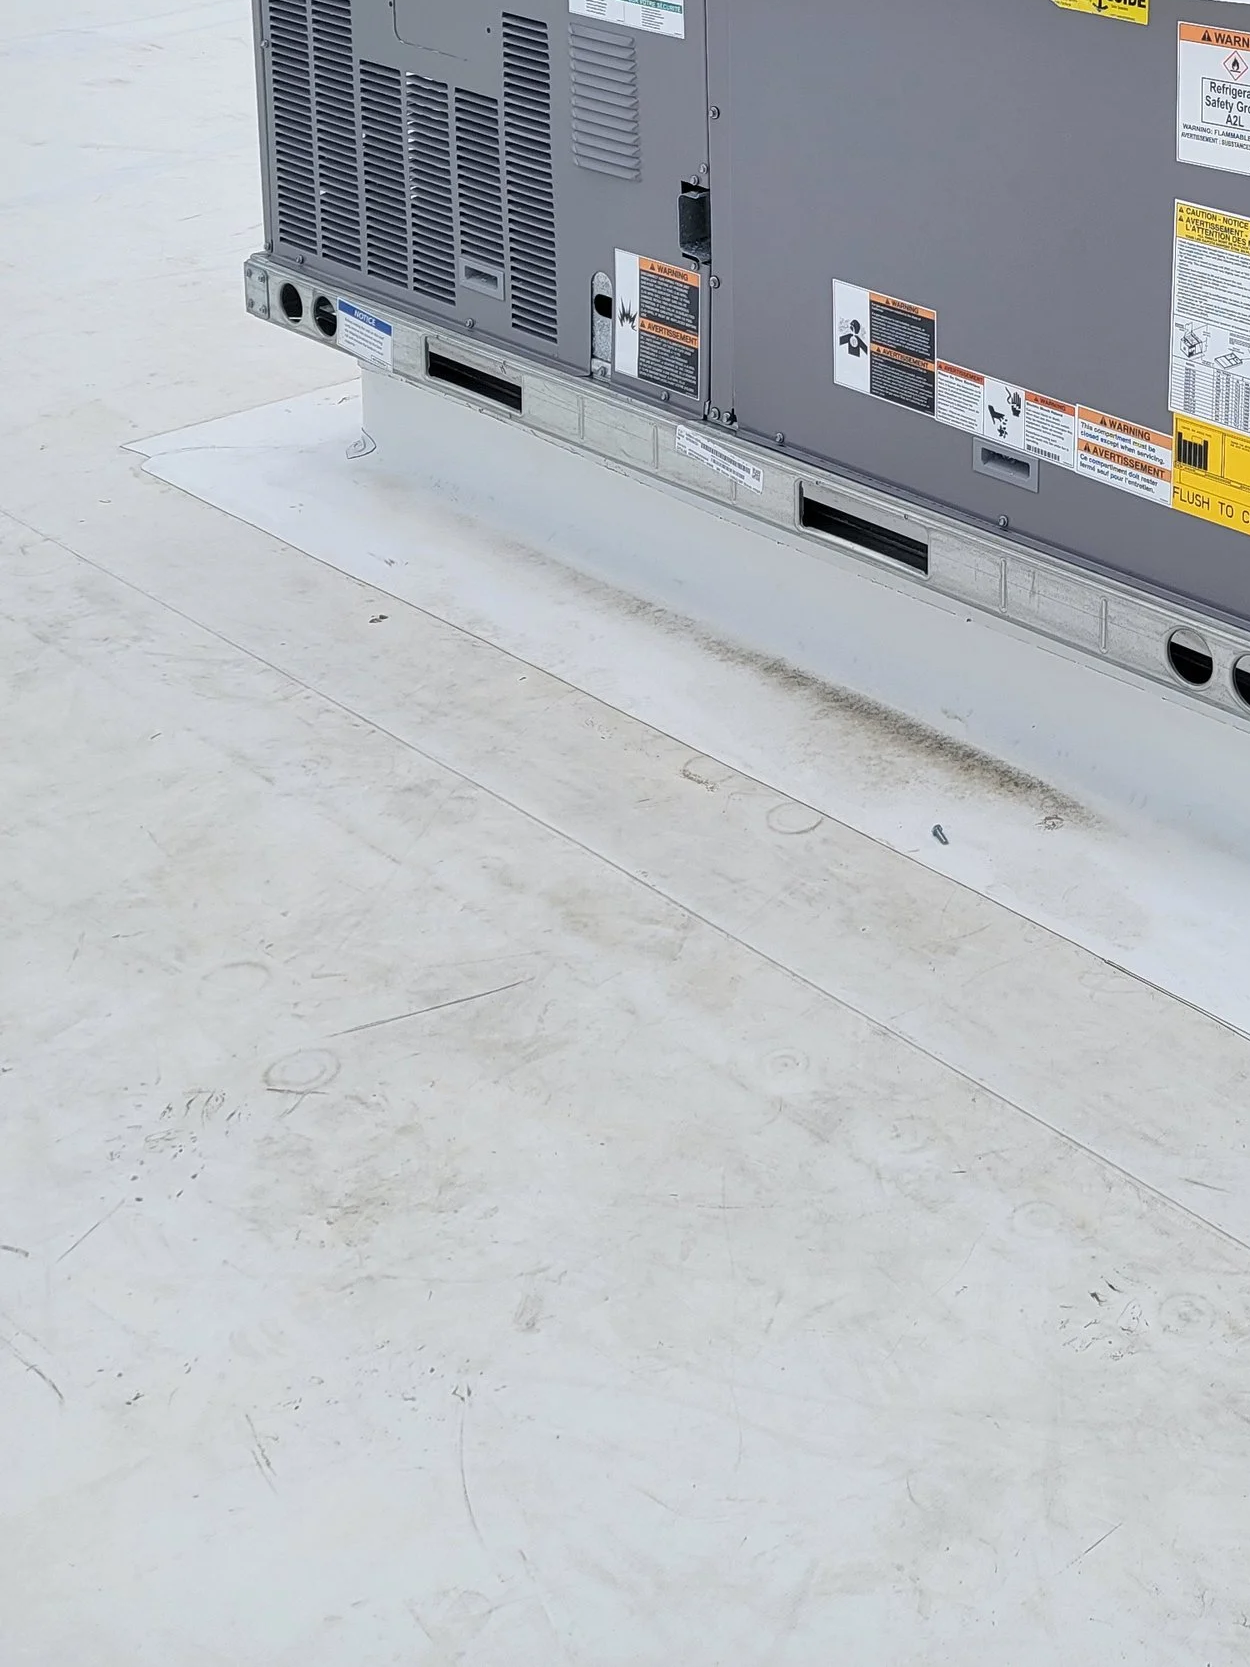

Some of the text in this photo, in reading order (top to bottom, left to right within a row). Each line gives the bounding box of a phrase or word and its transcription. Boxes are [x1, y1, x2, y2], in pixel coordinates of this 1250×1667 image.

[1205, 95, 1234, 114] Safety
[1182, 123, 1213, 135] WARNING:
[1226, 114, 1244, 128] A2L
[1181, 132, 1219, 145] AVERTISSEMENT
[1185, 207, 1217, 222] CAUTION
[1222, 217, 1249, 231] NOTICE
[1185, 217, 1244, 238] AVERTISSEMENT
[1185, 224, 1231, 241] L'ATTENTION
[1232, 236, 1247, 246] DES
[656, 266, 689, 281] WARNING
[891, 299, 919, 314] WARNING
[353, 309, 376, 327] NOTICE
[647, 322, 698, 346] AVERTISSEMENT
[882, 348, 929, 369] AVERTISSEMENT
[944, 365, 983, 383] AVERTISSEMENT
[1040, 396, 1066, 412] WARNING
[1080, 422, 1156, 453] This compartment must be
[1108, 419, 1151, 441] WARNING
[1080, 431, 1165, 466] closed except when servicing.
[1080, 453, 1159, 487] Ce compartiment doit rester
[1092, 445, 1165, 479] AVERTISSEMENT
[1080, 461, 1155, 494] fermé sauf pour l'entretien.
[1172, 485, 1210, 511] FLUSH
[1218, 501, 1234, 519] TO
